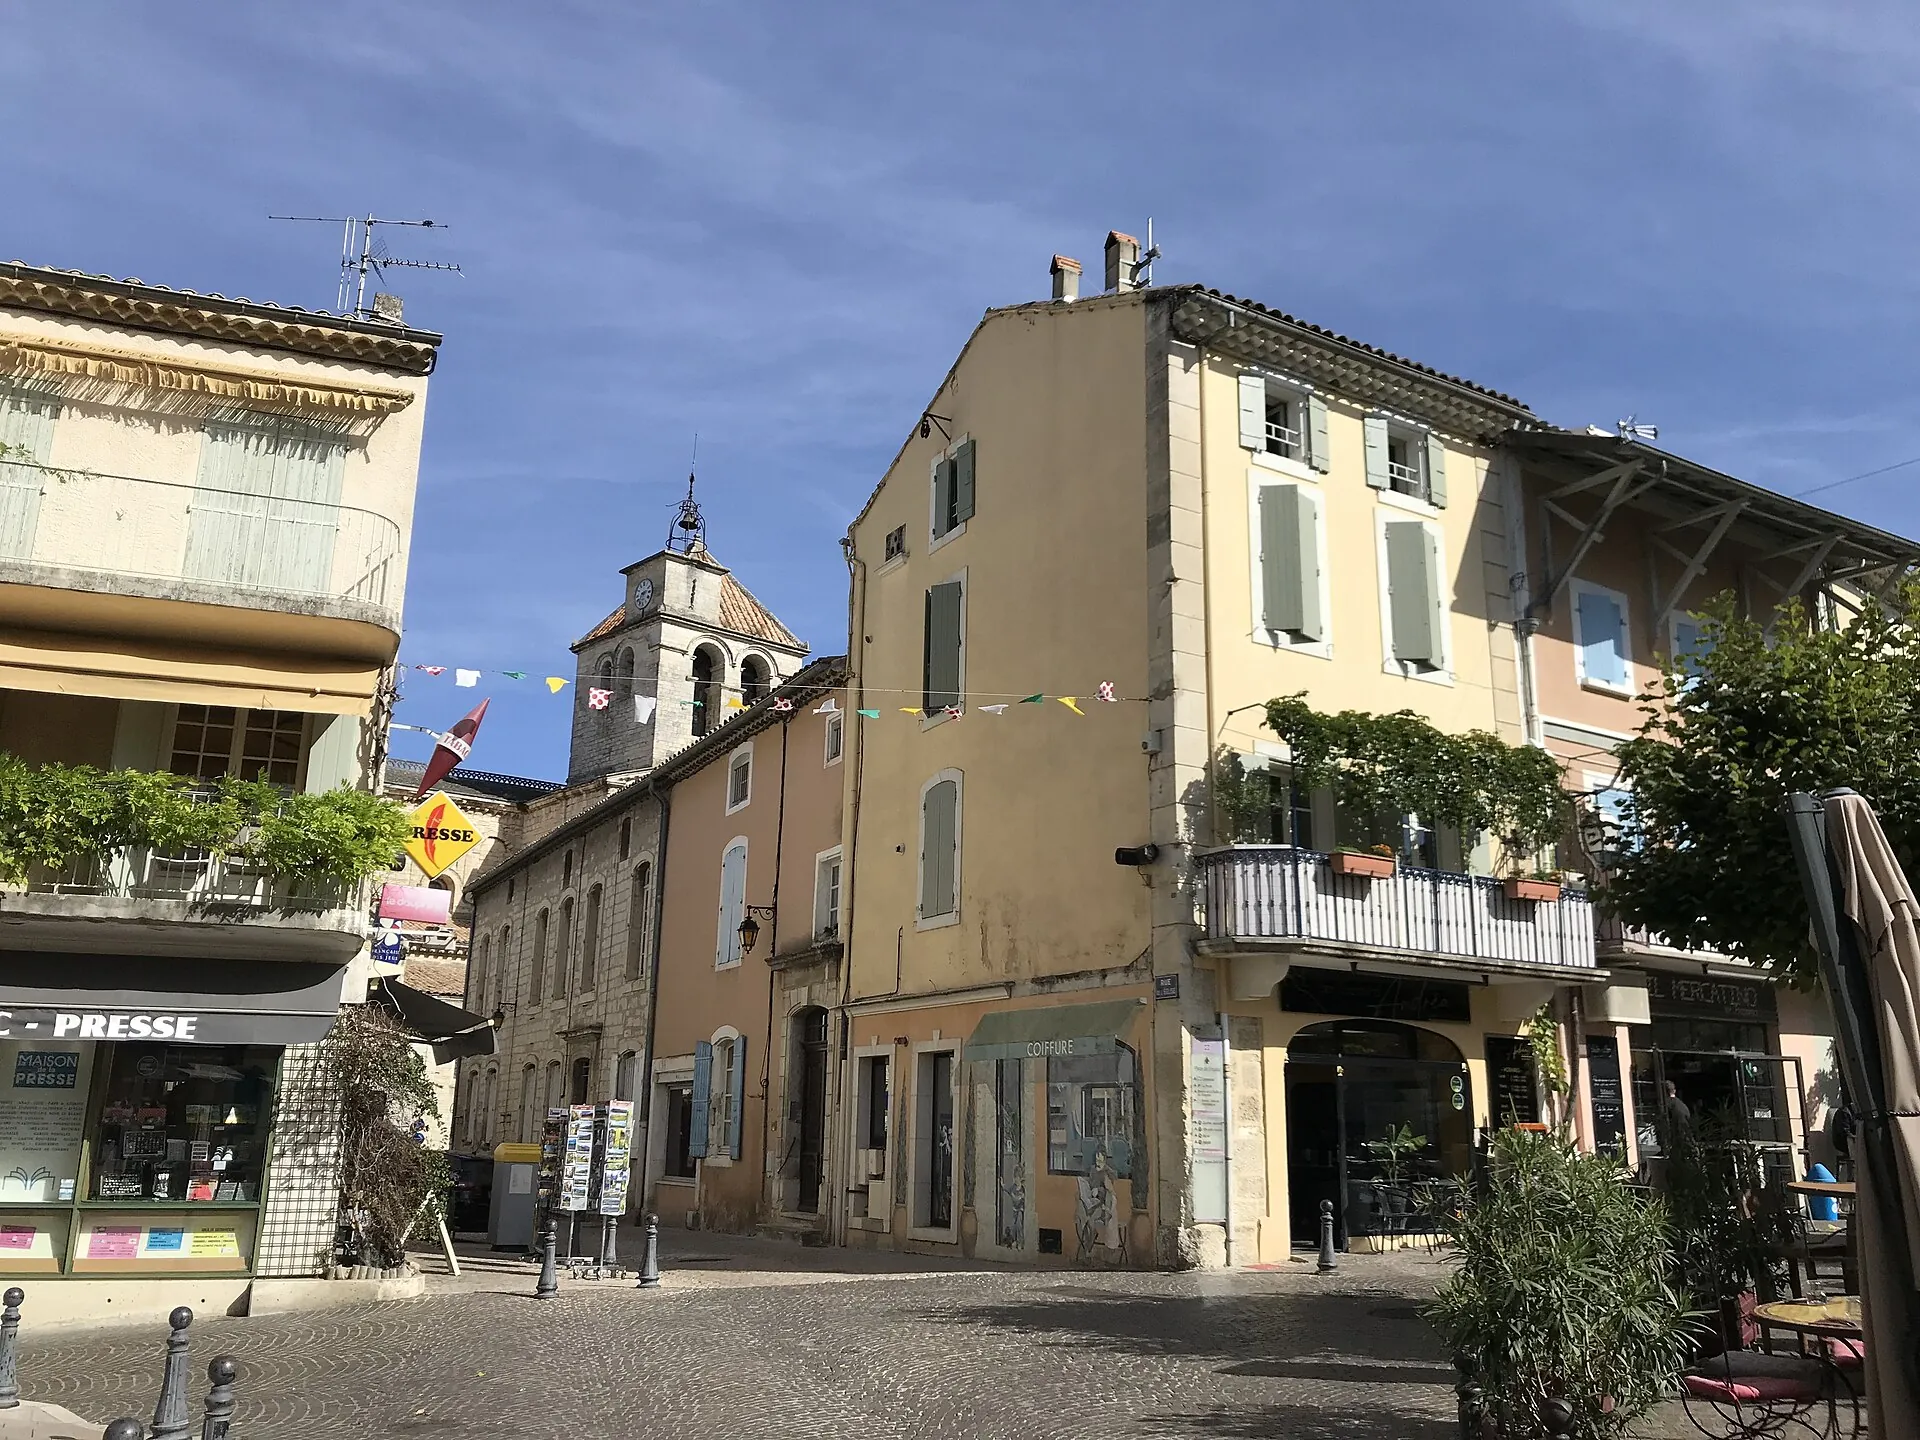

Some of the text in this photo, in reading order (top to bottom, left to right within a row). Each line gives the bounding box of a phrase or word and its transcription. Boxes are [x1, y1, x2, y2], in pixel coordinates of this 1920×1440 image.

[411, 826, 474, 843] RESSE
[53, 1013, 198, 1040] PRESSE
[1026, 1040, 1074, 1057] COIFFURE
[17, 1055, 78, 1068] MAISON
[15, 1072, 75, 1086] PRESSE
